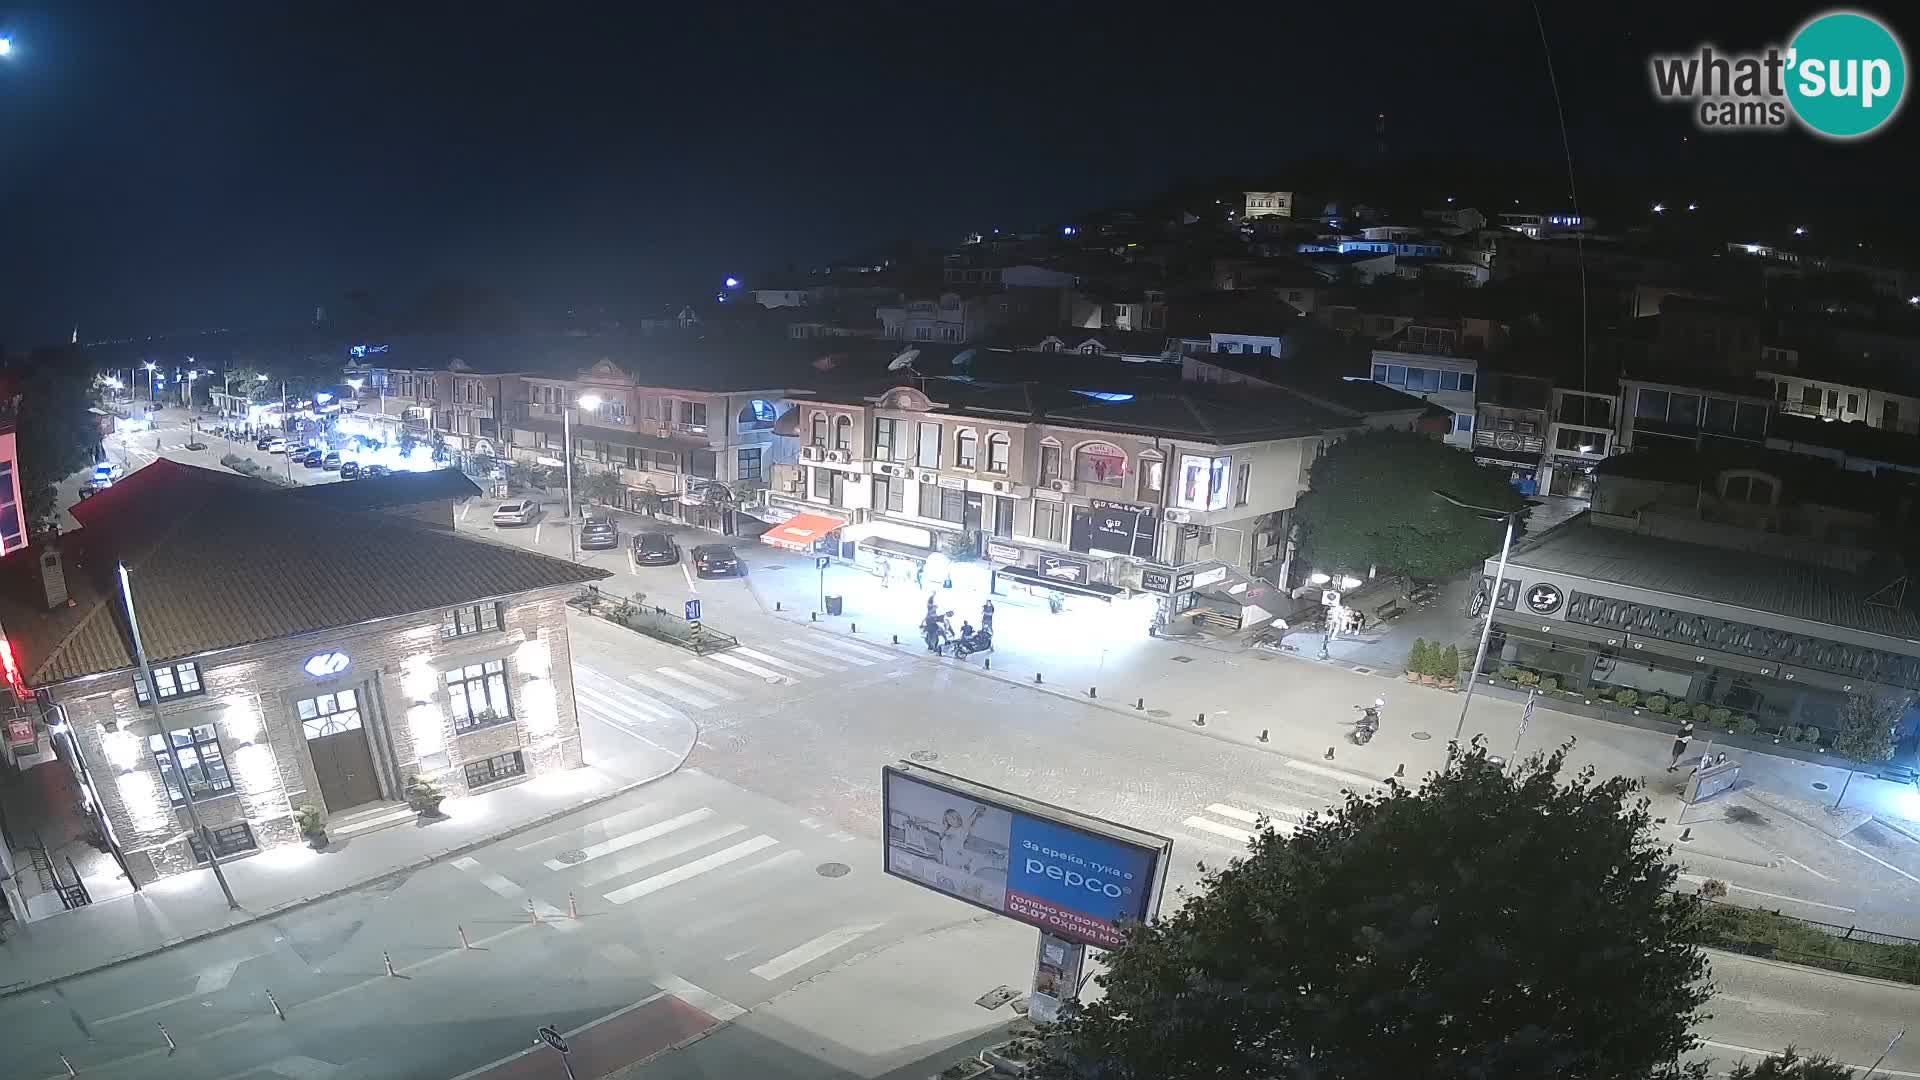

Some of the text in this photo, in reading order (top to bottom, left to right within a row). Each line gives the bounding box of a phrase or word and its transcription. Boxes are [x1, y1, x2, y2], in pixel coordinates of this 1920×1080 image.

[1022, 839, 1039, 851] За
[1089, 862, 1121, 876] тука
[1123, 872, 1133, 880] е
[1025, 857, 1122, 899] pepco
[1009, 903, 1048, 920] 02.07
[1049, 916, 1096, 939] Охрид
